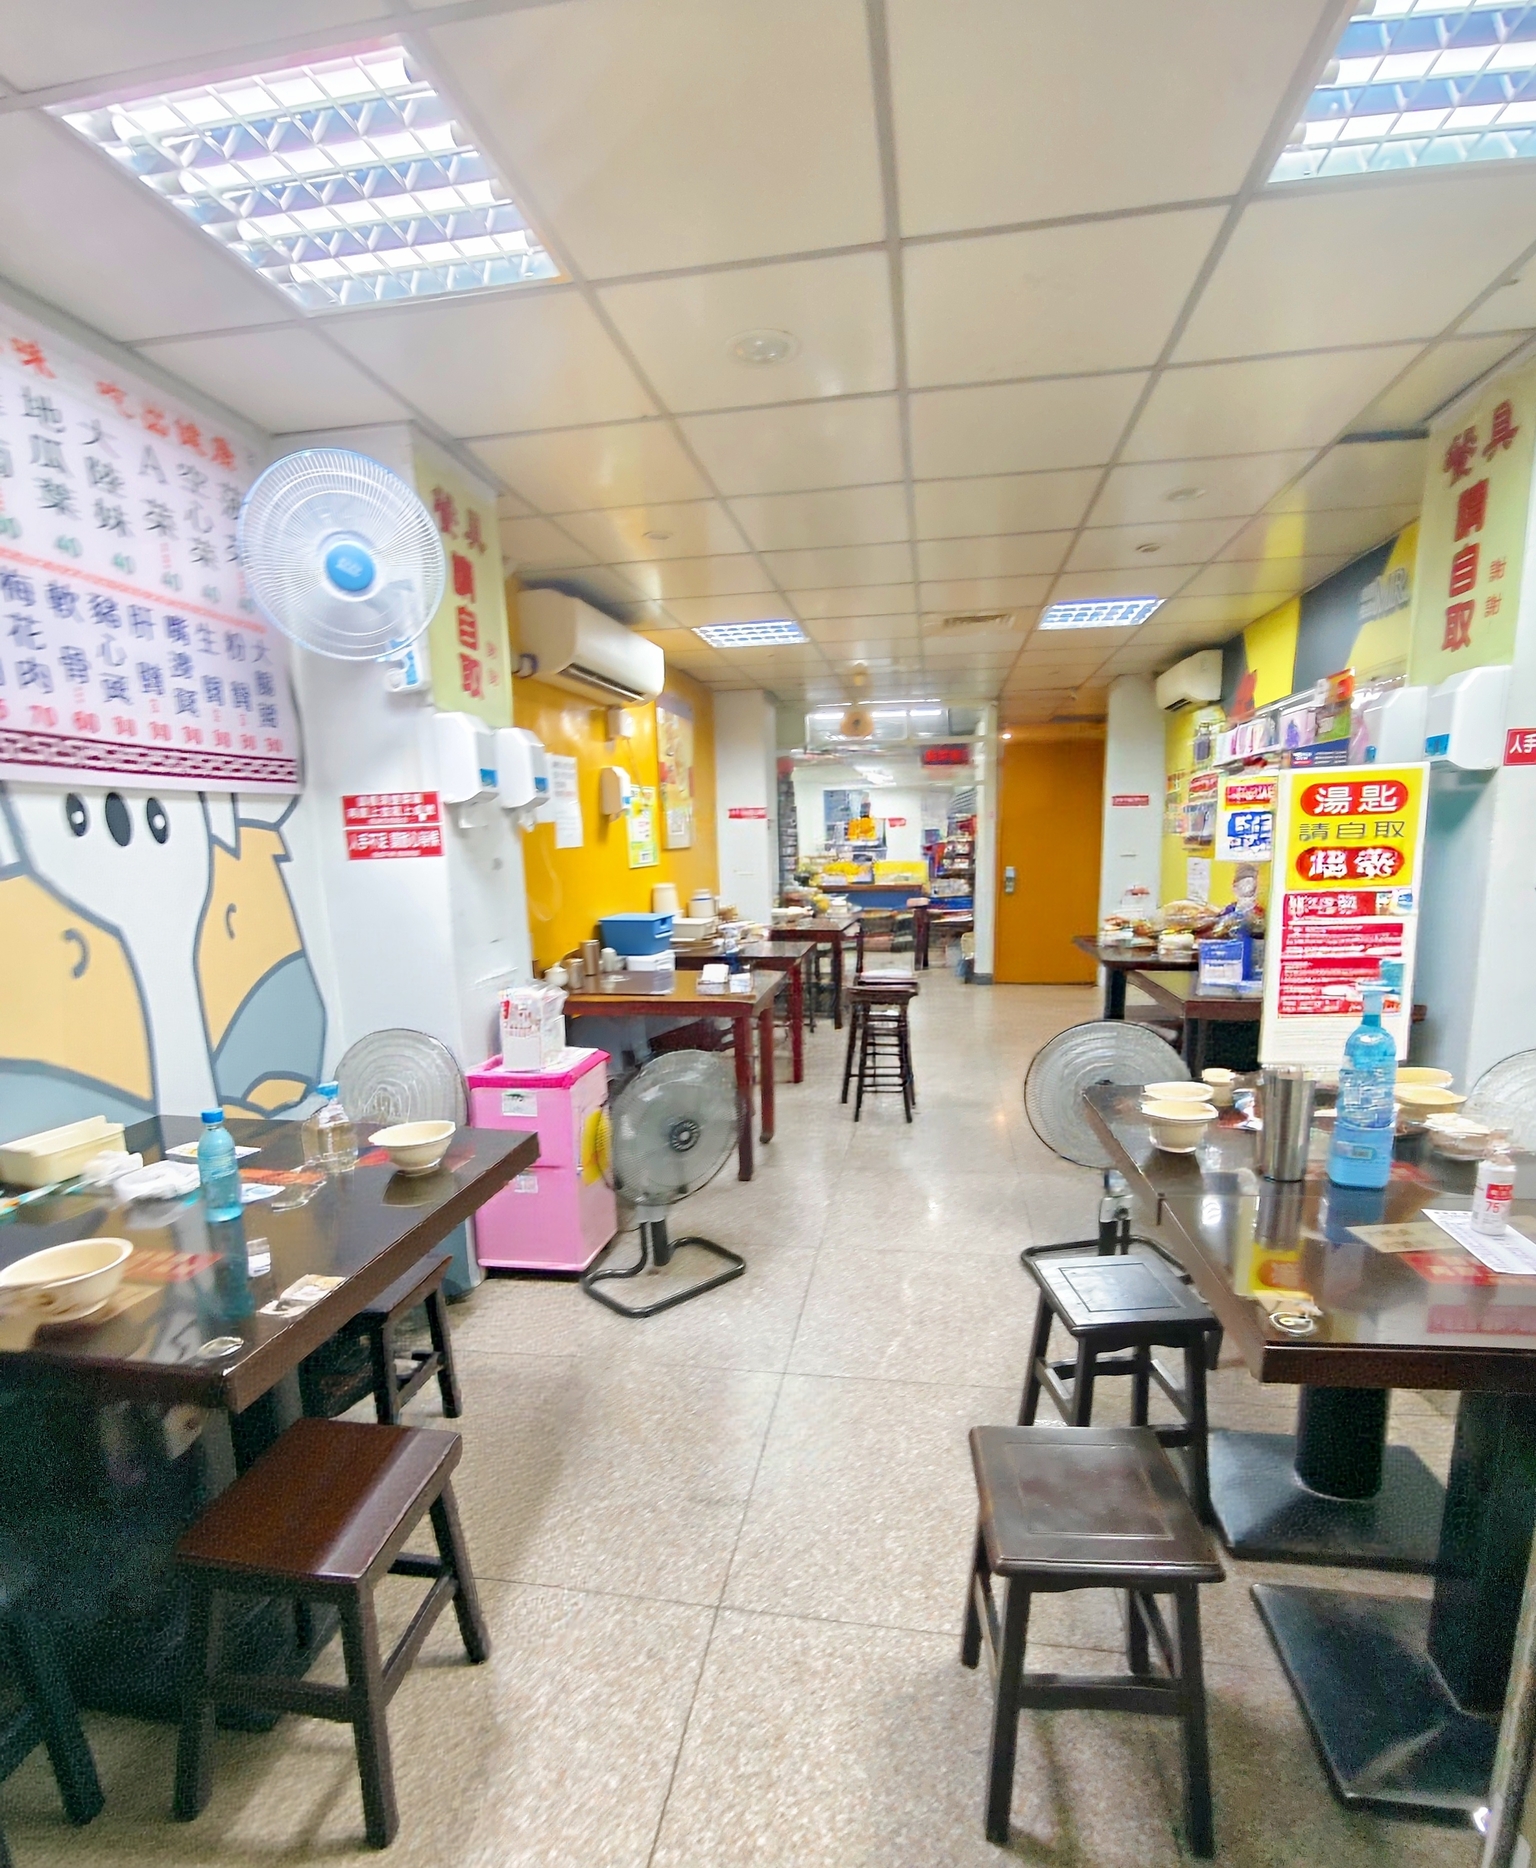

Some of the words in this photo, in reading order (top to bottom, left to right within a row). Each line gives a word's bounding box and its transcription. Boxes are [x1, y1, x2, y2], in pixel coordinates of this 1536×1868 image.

[1313, 784, 1398, 814] 湯匙
[1299, 820, 1405, 842] 請自取
